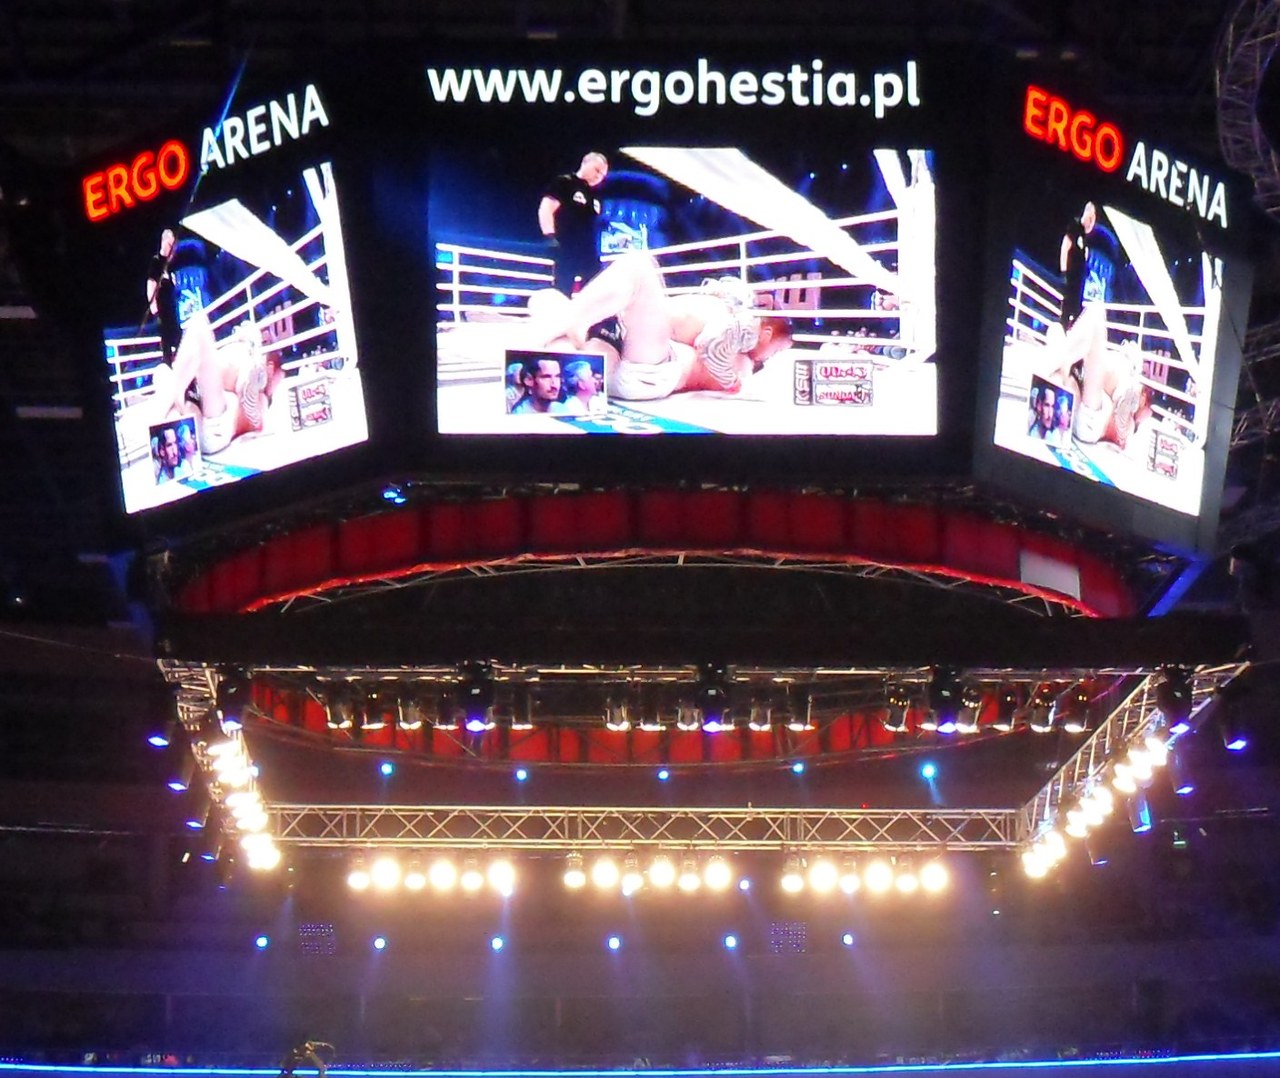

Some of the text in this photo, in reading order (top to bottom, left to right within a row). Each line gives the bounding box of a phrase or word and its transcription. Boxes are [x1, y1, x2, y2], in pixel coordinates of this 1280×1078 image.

[83, 83, 330, 222] ERGO ARENA
[427, 59, 921, 118] www.ergohestia.pl
[1024, 84, 1228, 229] ERGO ARENA
